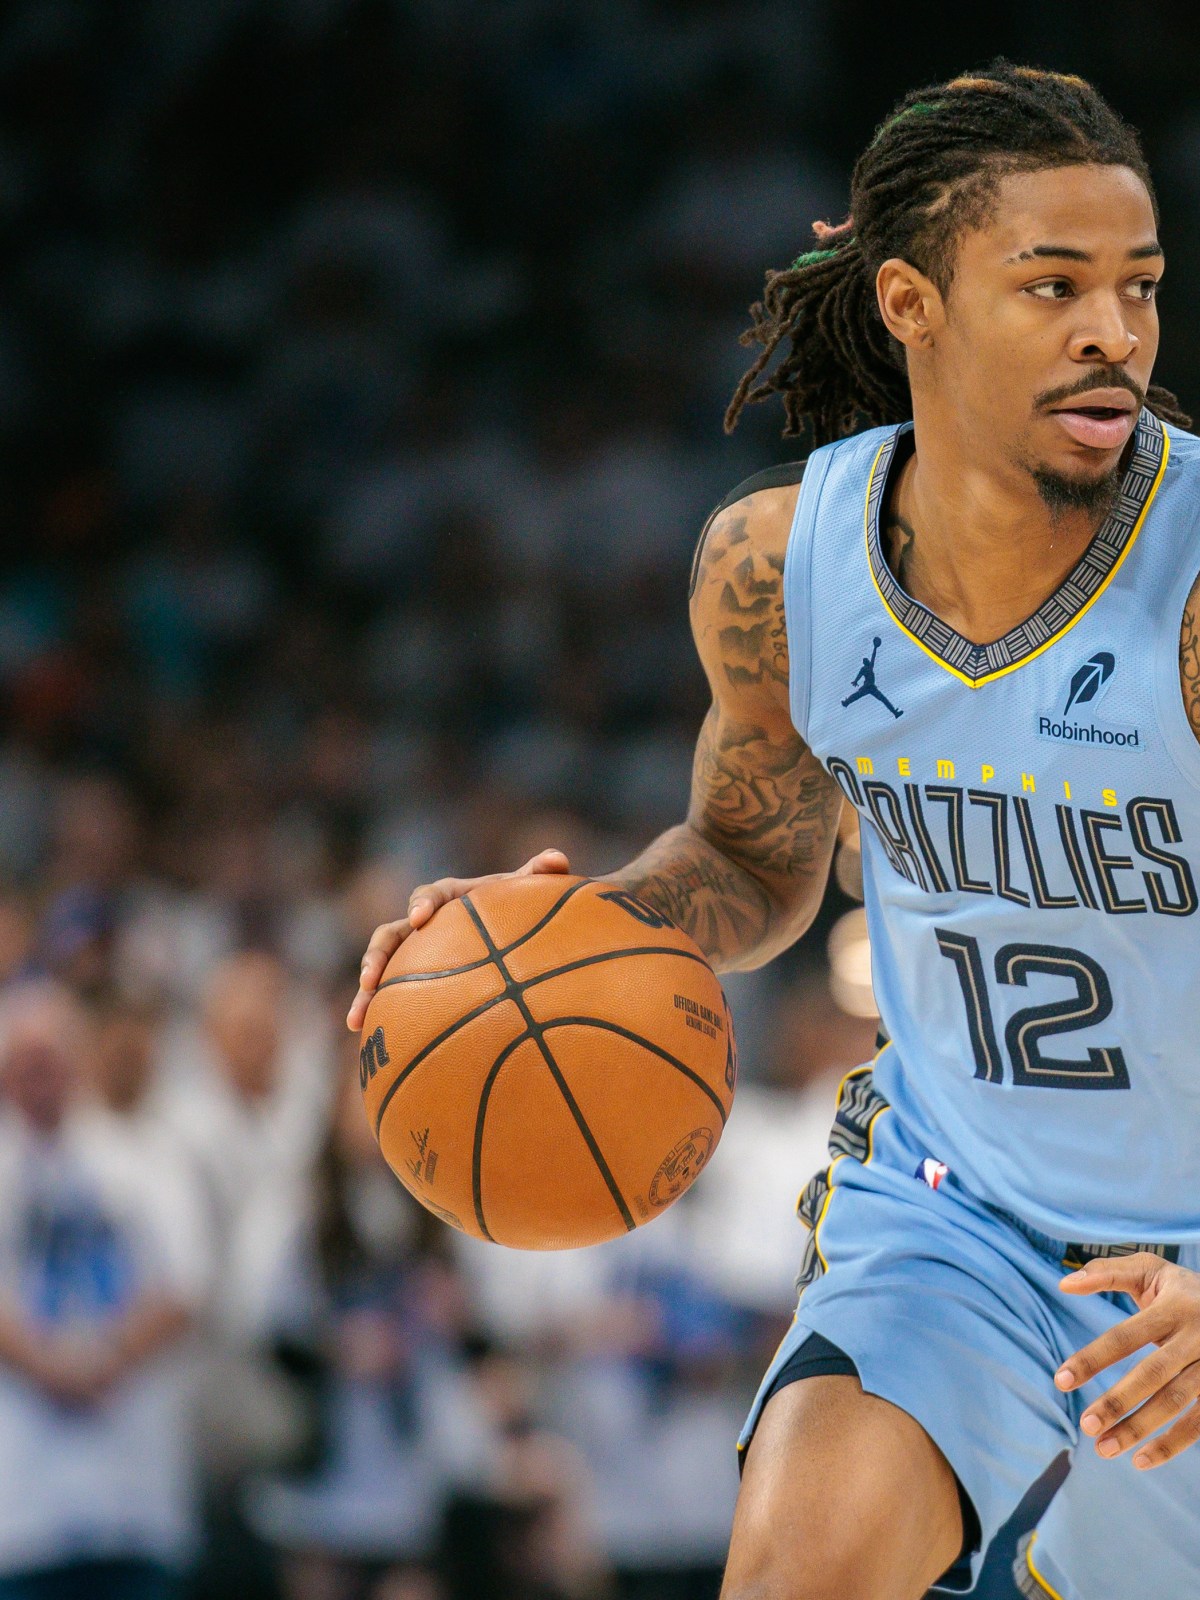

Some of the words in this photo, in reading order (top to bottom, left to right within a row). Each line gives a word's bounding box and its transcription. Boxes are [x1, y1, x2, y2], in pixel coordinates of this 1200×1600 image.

[1039, 716, 1139, 748] Robinhood
[856, 757, 1118, 807] MEMPHIS
[674, 994, 699, 1016] OFFICIAL
[934, 927, 1131, 1090] 12
